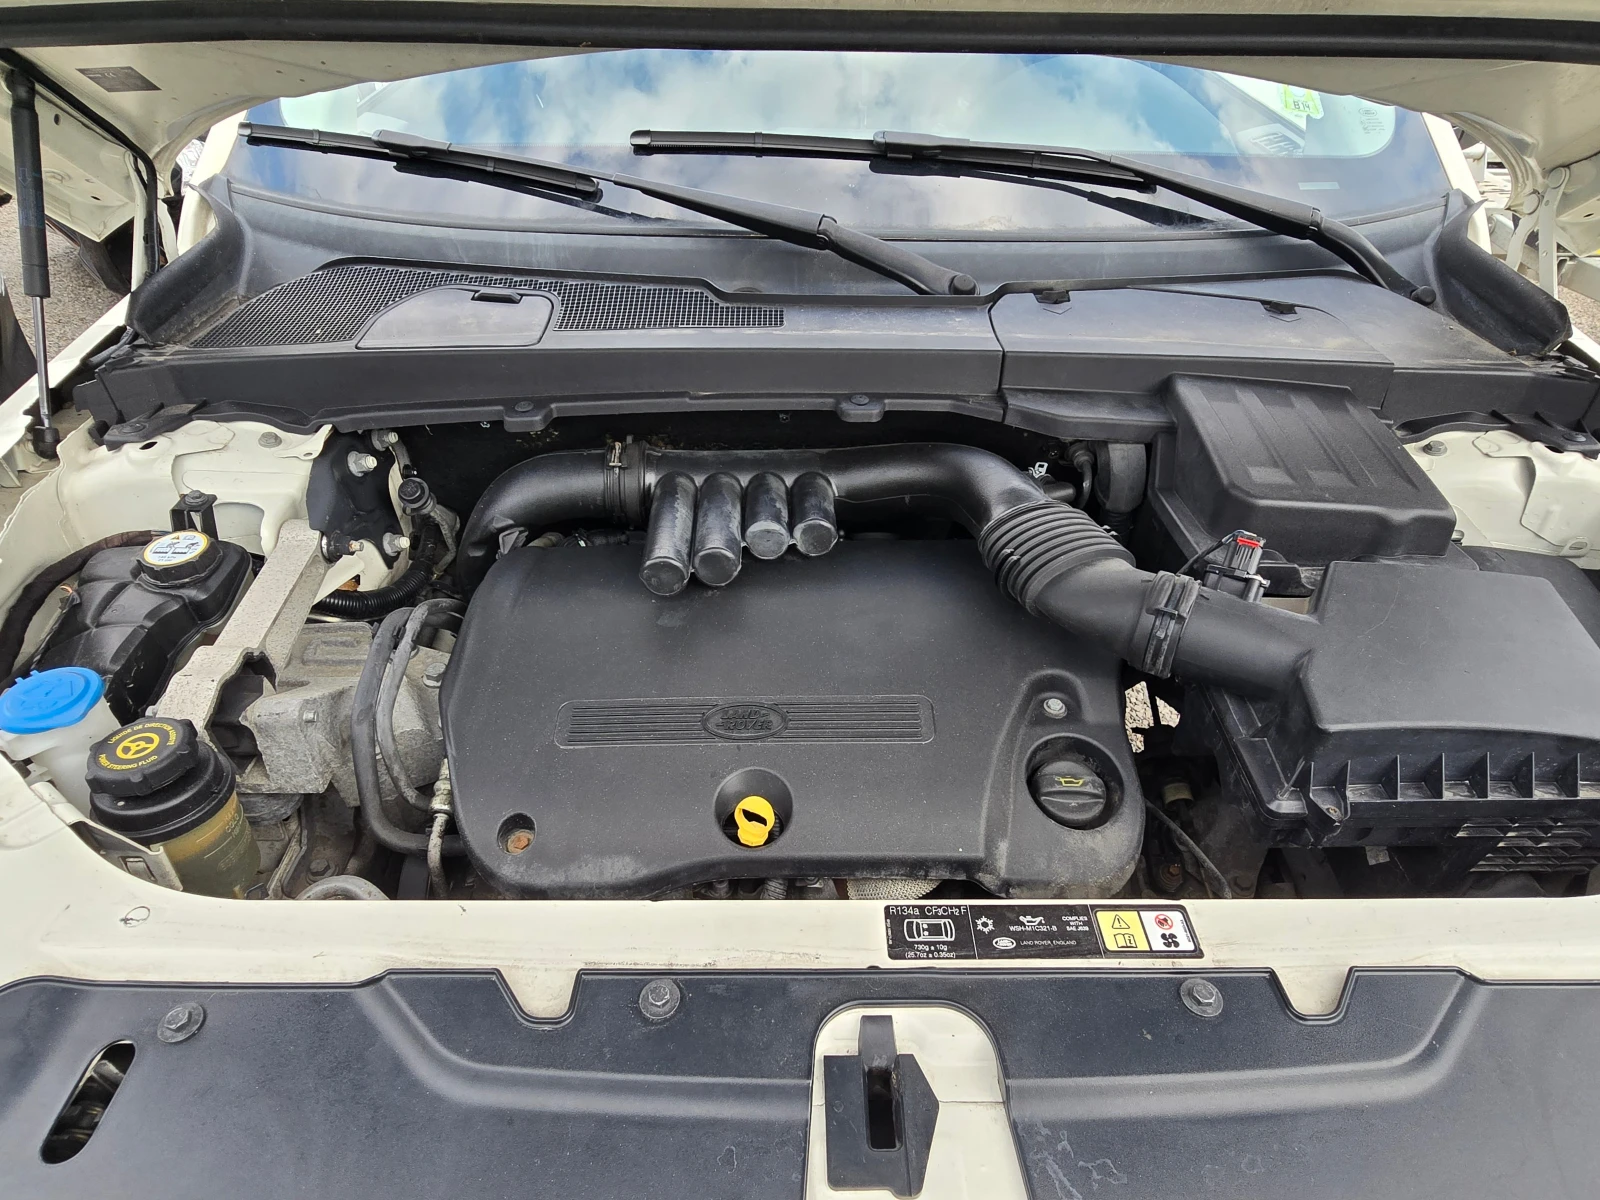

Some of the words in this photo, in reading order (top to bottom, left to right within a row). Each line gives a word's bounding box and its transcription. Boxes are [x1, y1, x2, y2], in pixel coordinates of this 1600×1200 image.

[724, 719, 773, 731] ROVER
[138, 755, 158, 766] FLUID
[889, 906, 920, 915] R134a
